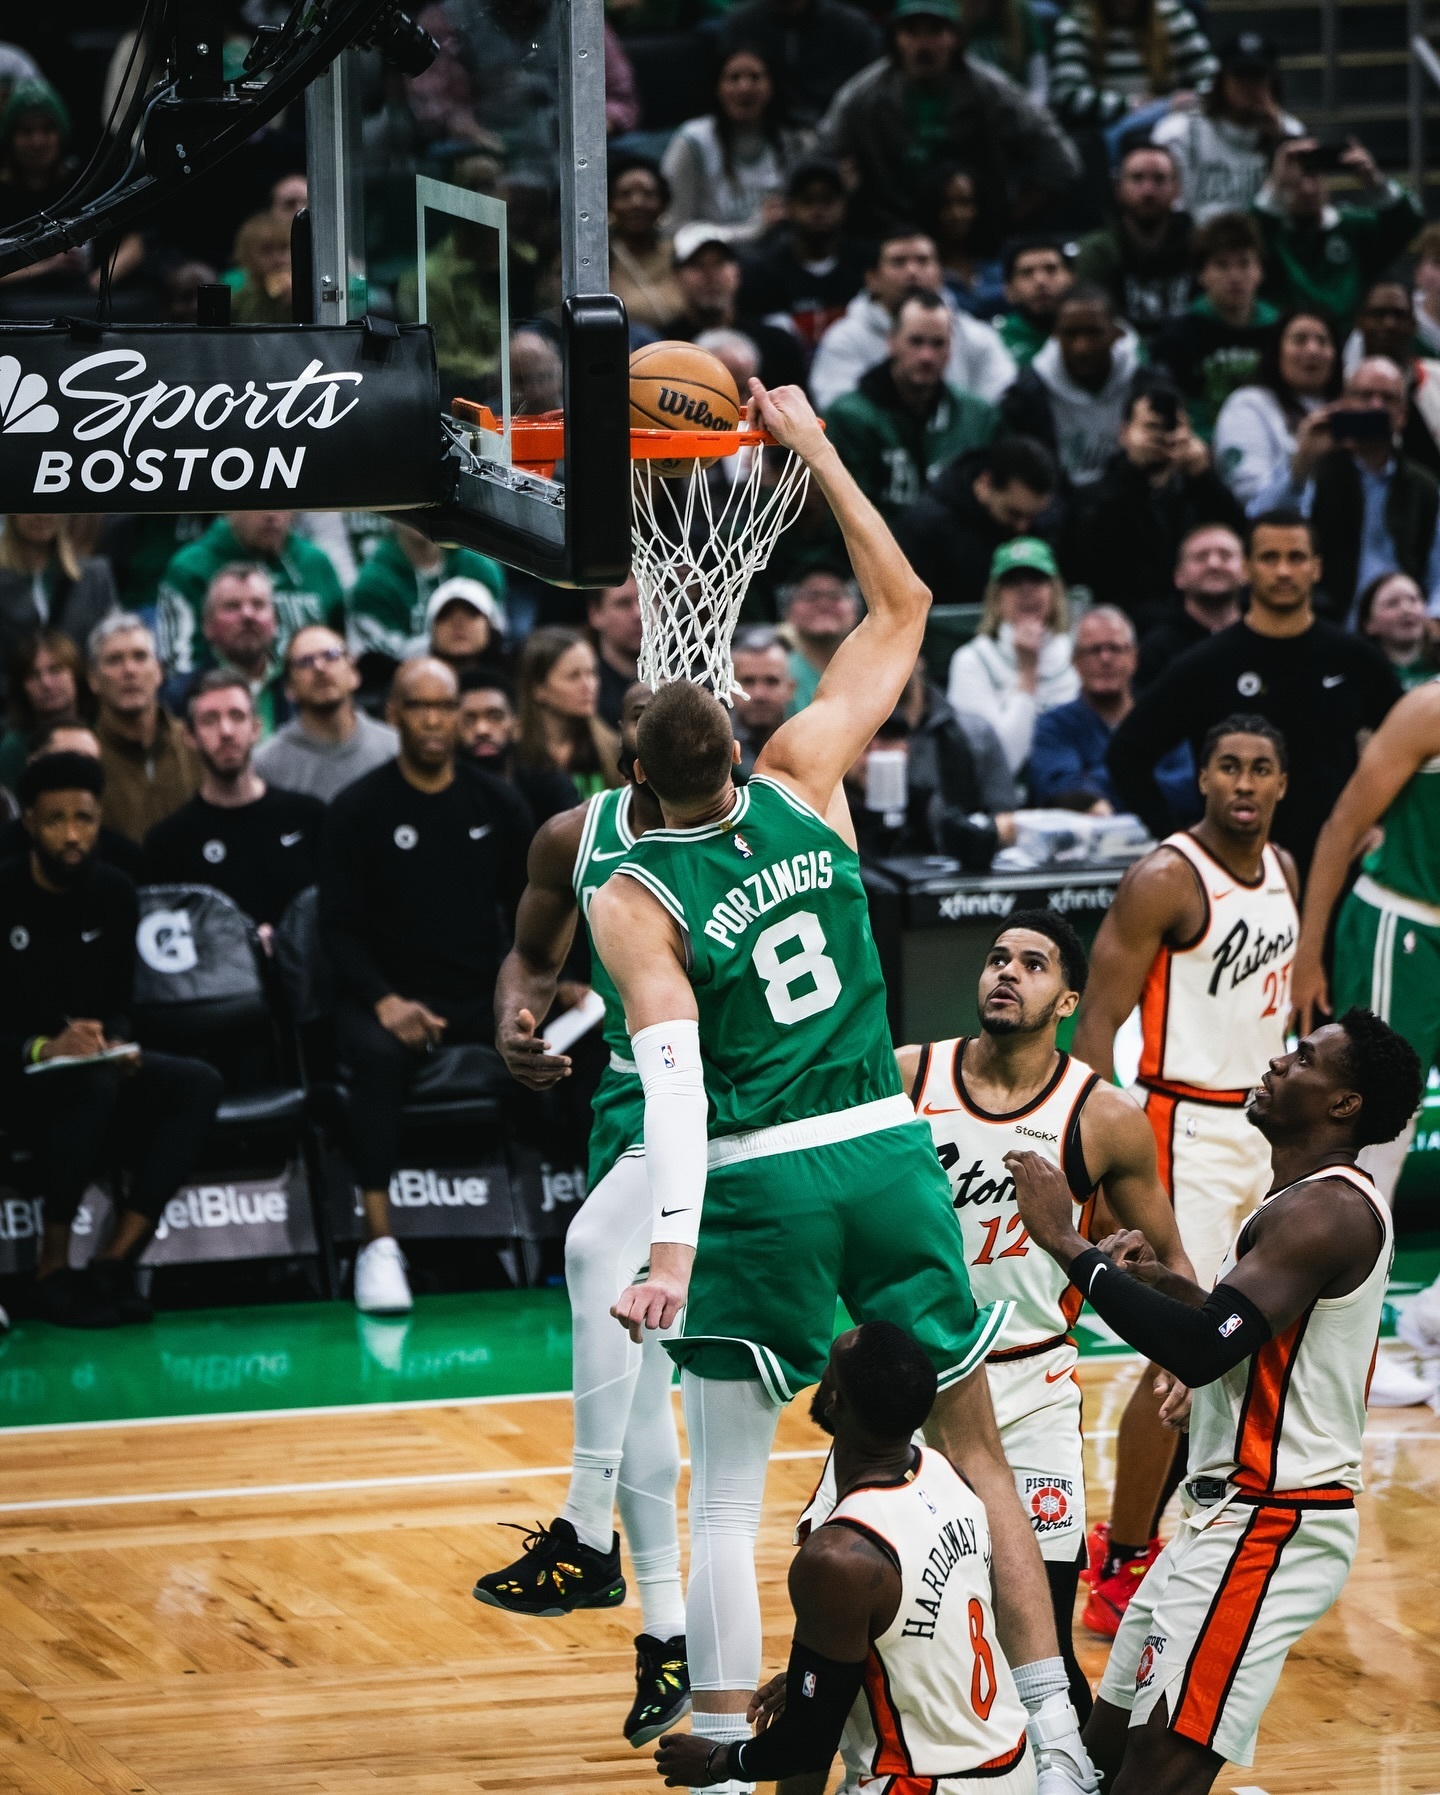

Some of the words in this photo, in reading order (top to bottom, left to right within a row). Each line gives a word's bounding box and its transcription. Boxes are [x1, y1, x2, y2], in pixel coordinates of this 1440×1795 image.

[58, 349, 363, 458] Sports
[658, 386, 733, 431] Wilson
[33, 446, 306, 493] BOSTON
[704, 850, 833, 950] PORZINGIS
[939, 891, 1016, 920] xfinity
[751, 910, 843, 1025] 8
[1208, 918, 1294, 997] Pistons
[1014, 1125, 1059, 1143] StockX
[970, 1212, 1030, 1267] 12
[1025, 1477, 1073, 1497] PISTONS
[901, 1517, 977, 1640] HARDAWAY
[968, 1597, 998, 1721] 8
